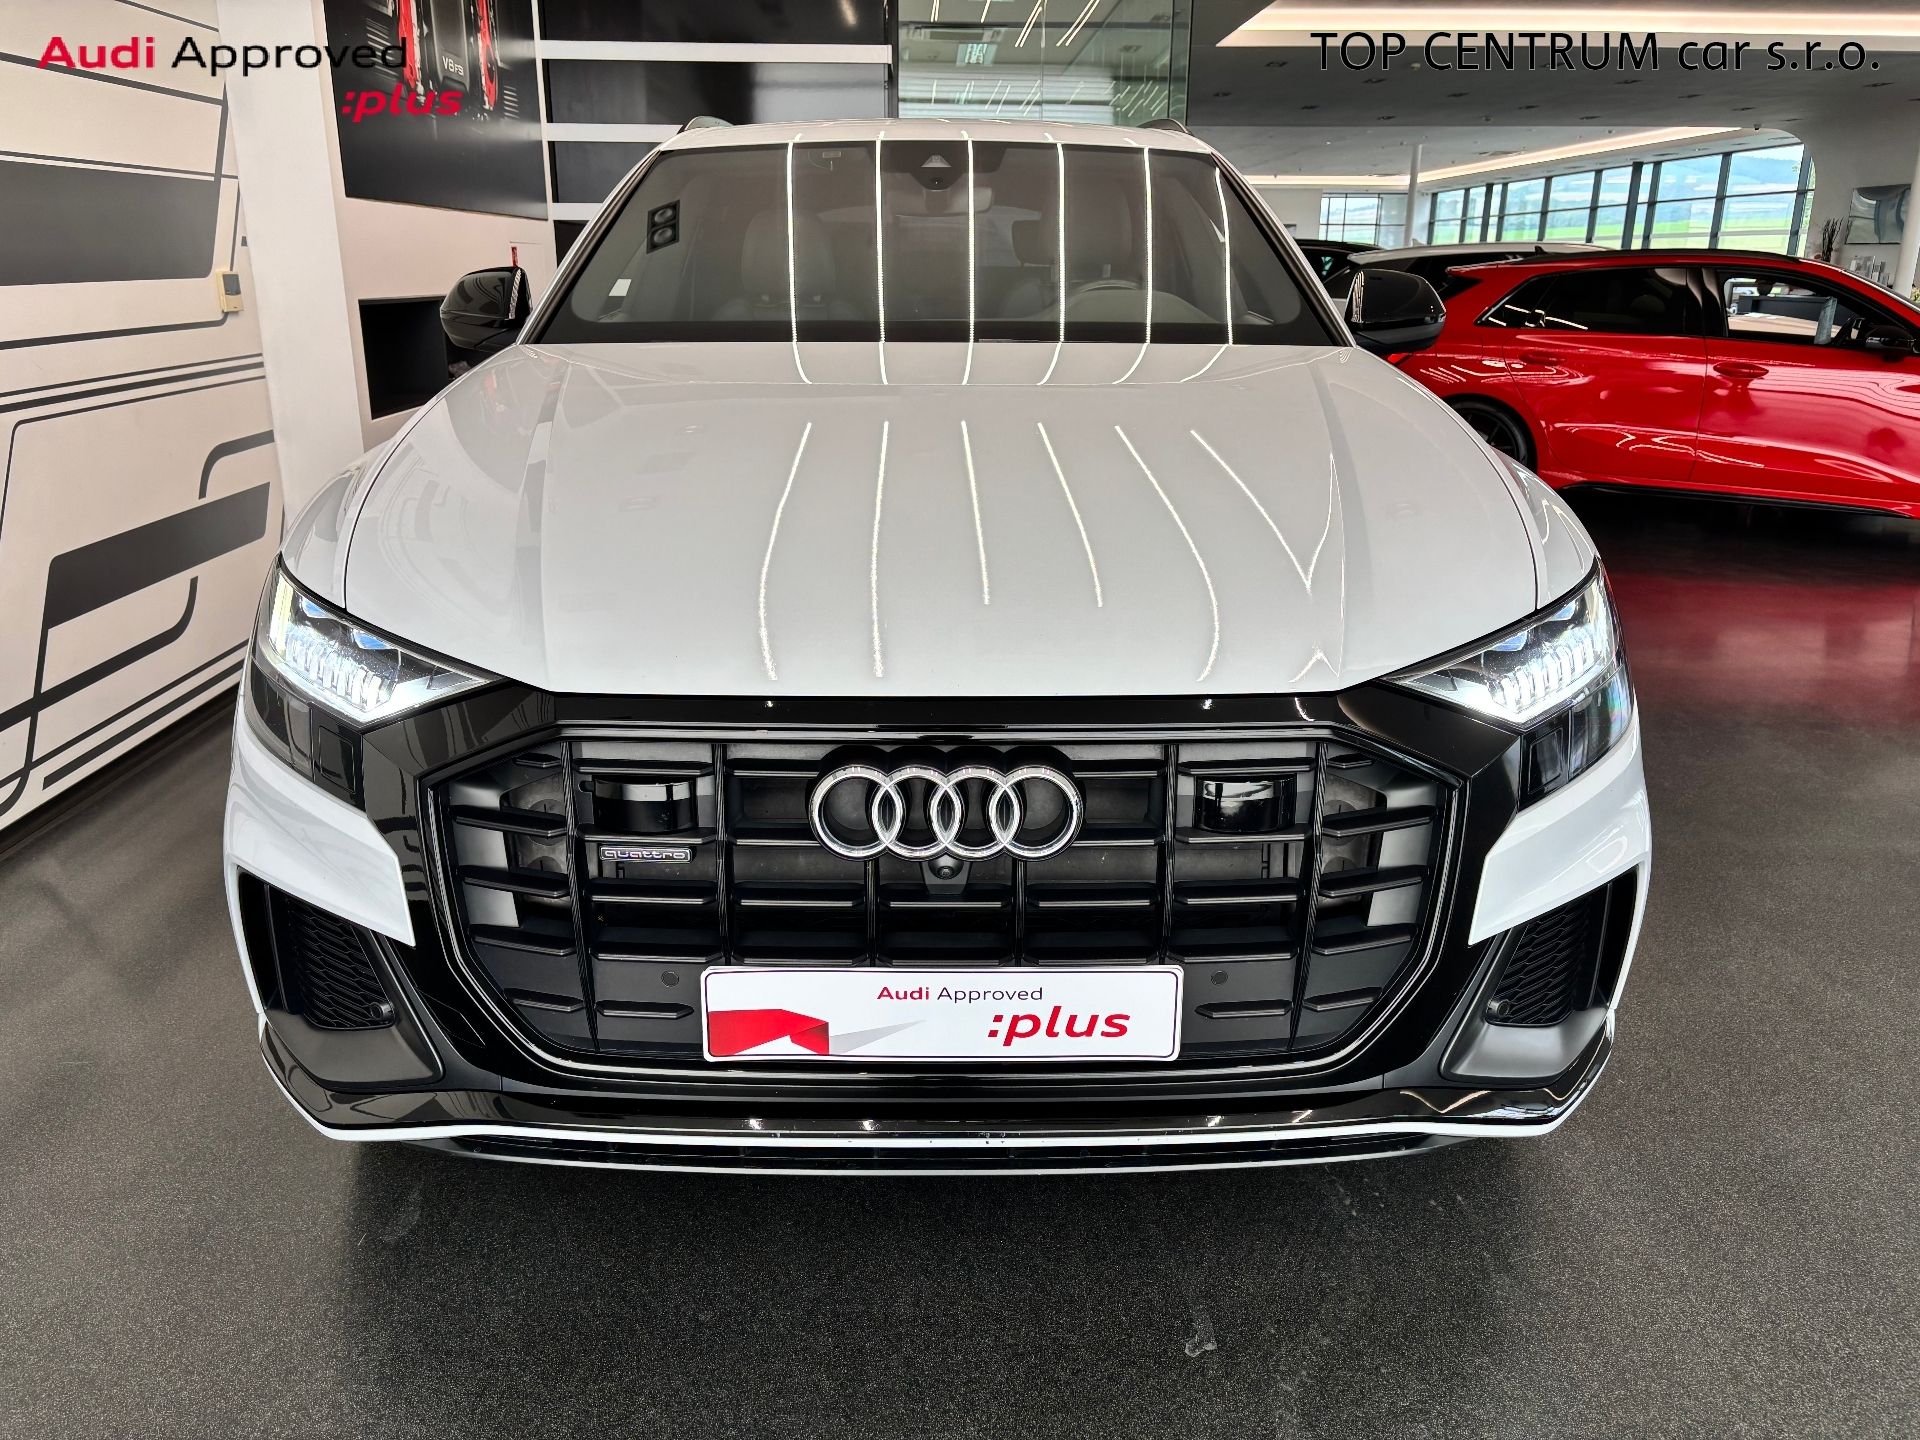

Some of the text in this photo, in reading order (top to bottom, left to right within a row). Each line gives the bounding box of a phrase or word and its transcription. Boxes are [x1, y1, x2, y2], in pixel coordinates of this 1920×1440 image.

[604, 850, 686, 860] quattro
[877, 986, 1043, 1004] Audi Approved
[987, 1005, 1131, 1047] :plus
